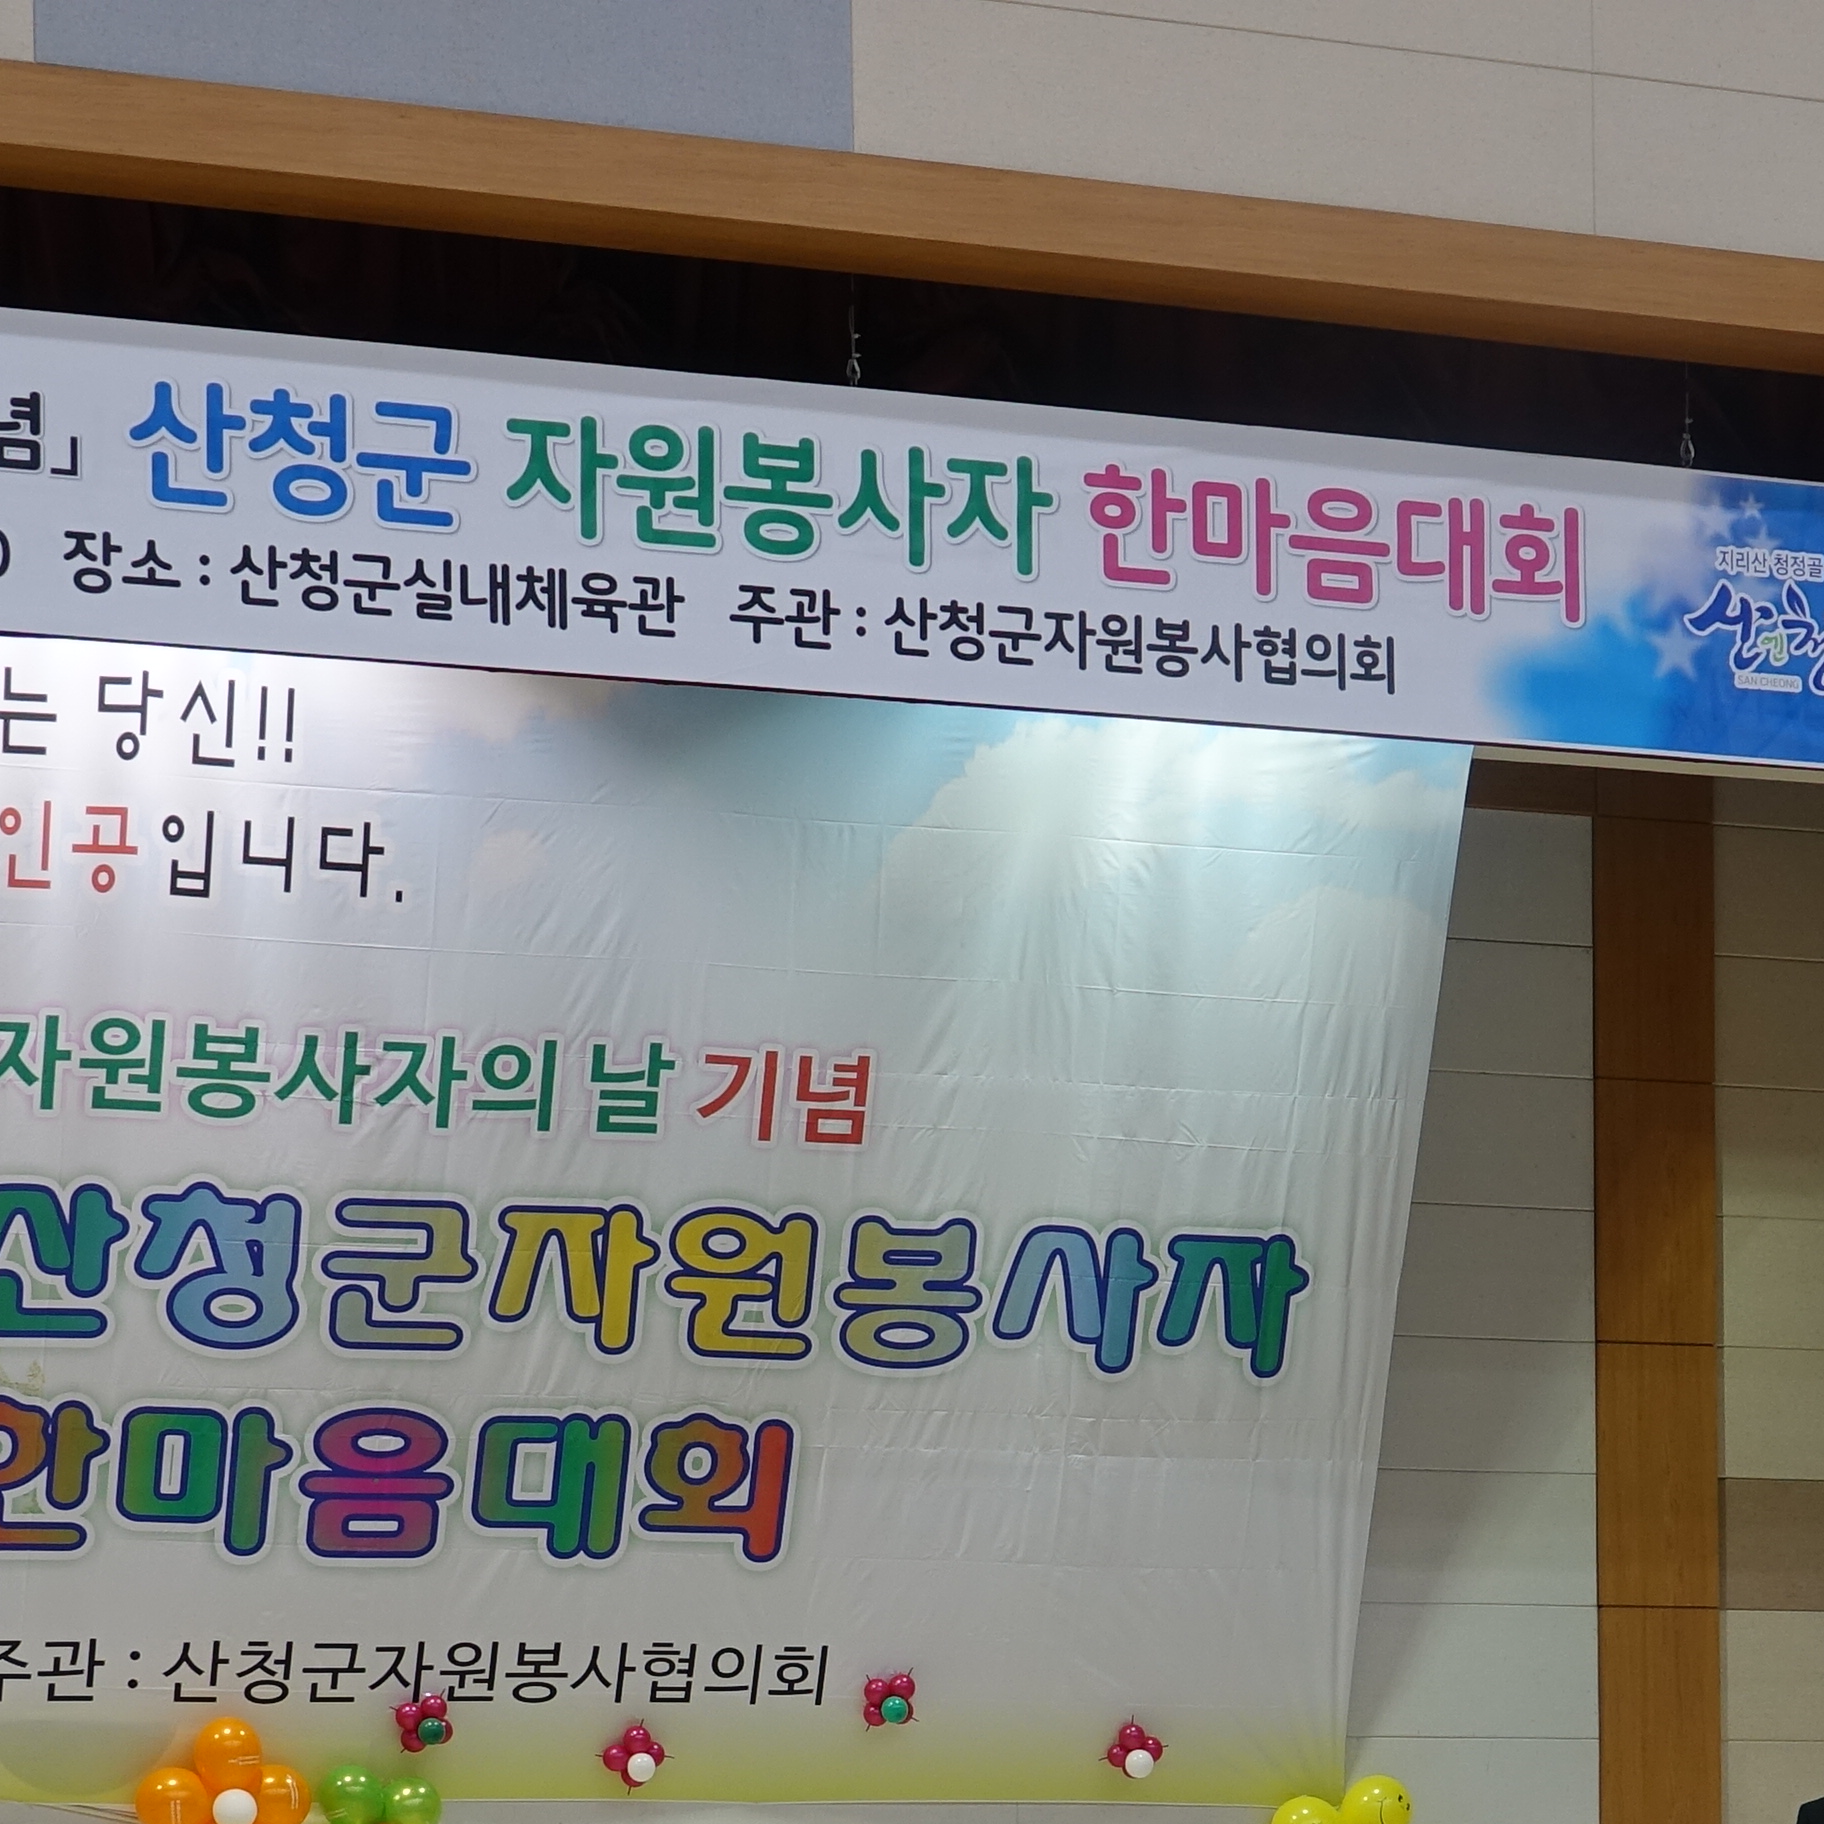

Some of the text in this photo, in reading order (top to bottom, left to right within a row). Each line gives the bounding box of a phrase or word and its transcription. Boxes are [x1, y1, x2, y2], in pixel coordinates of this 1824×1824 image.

[128, 380, 472, 528] 산청군
[505, 415, 1054, 577] 자원봉사자
[1082, 464, 1582, 624] 한마음대회
[1719, 549, 1823, 578] 지리산 청정골
[230, 543, 686, 638] 산청군실내체육관
[883, 596, 1397, 695] 산청군자원봉사협의회
[97, 670, 295, 768] 당신!!
[588, 1041, 676, 1136] 날
[696, 1050, 872, 1144] 기념
[163, 1641, 828, 1705] 산청군자원봉사협의회
